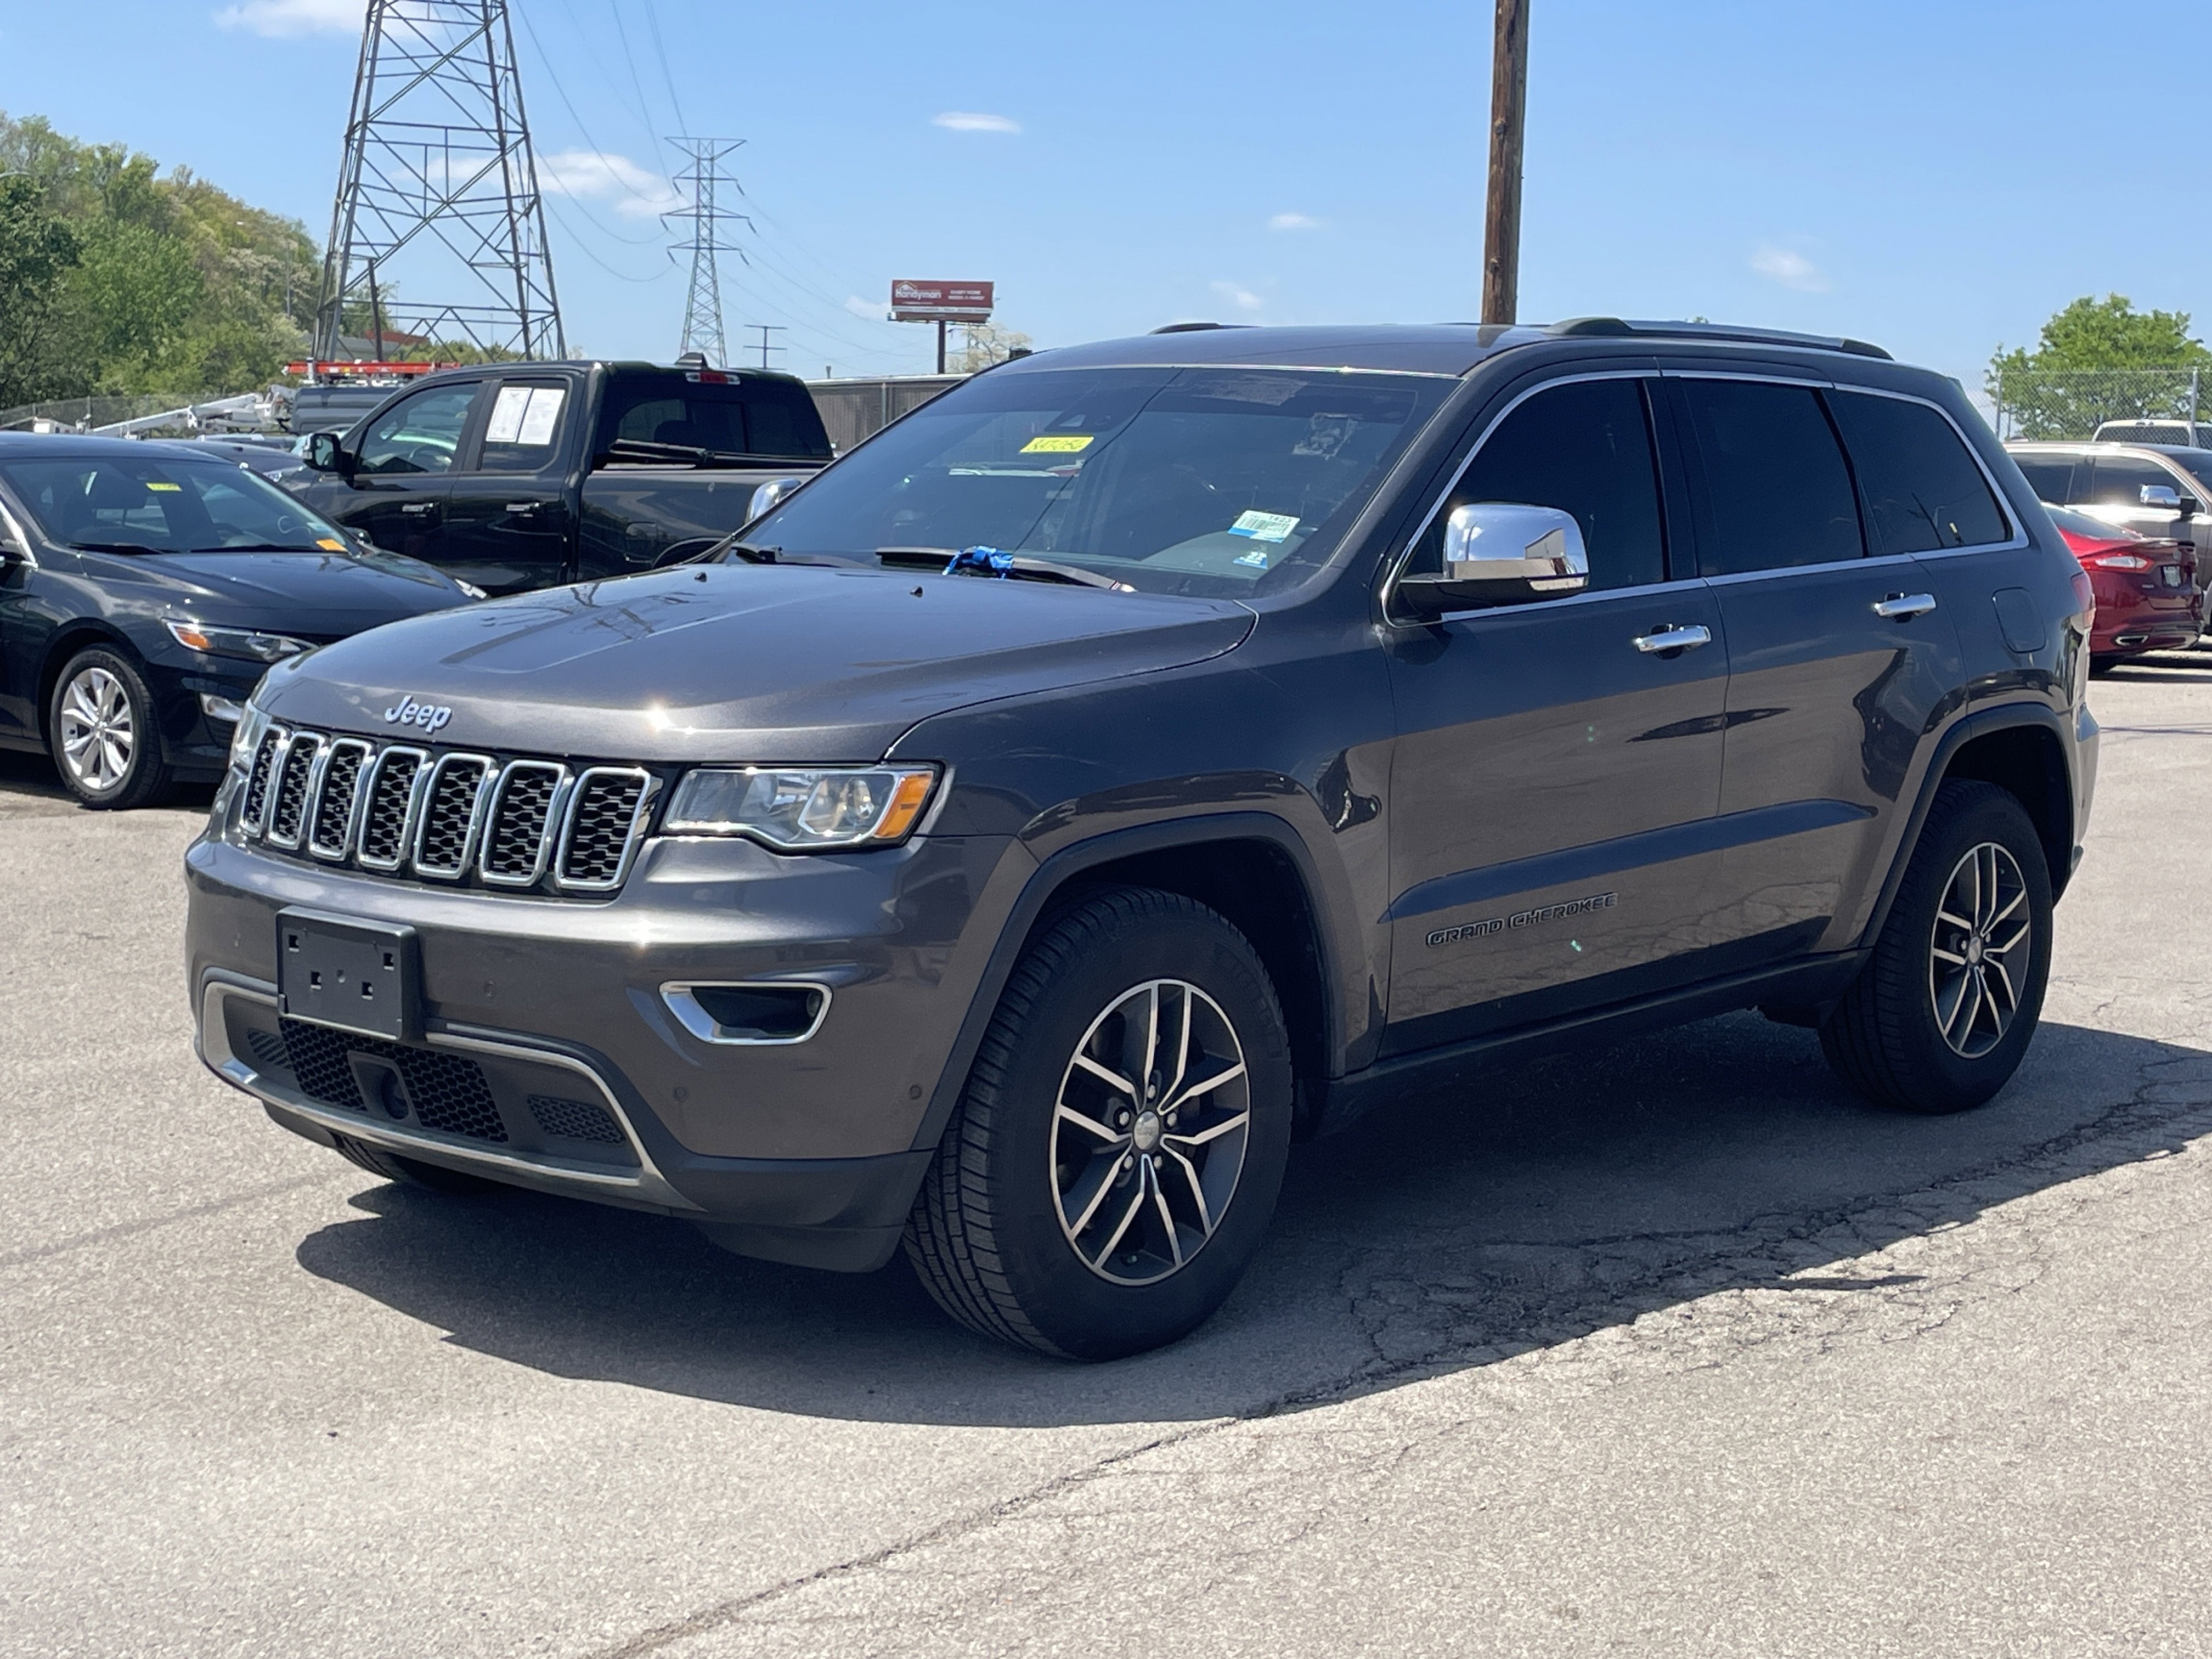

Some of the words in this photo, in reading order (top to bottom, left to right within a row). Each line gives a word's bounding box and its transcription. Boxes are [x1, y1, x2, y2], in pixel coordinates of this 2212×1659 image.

[385, 695, 452, 734] Jeep
[1426, 917, 1504, 947] GRAND
[1508, 891, 1618, 929] CHEROKEE
